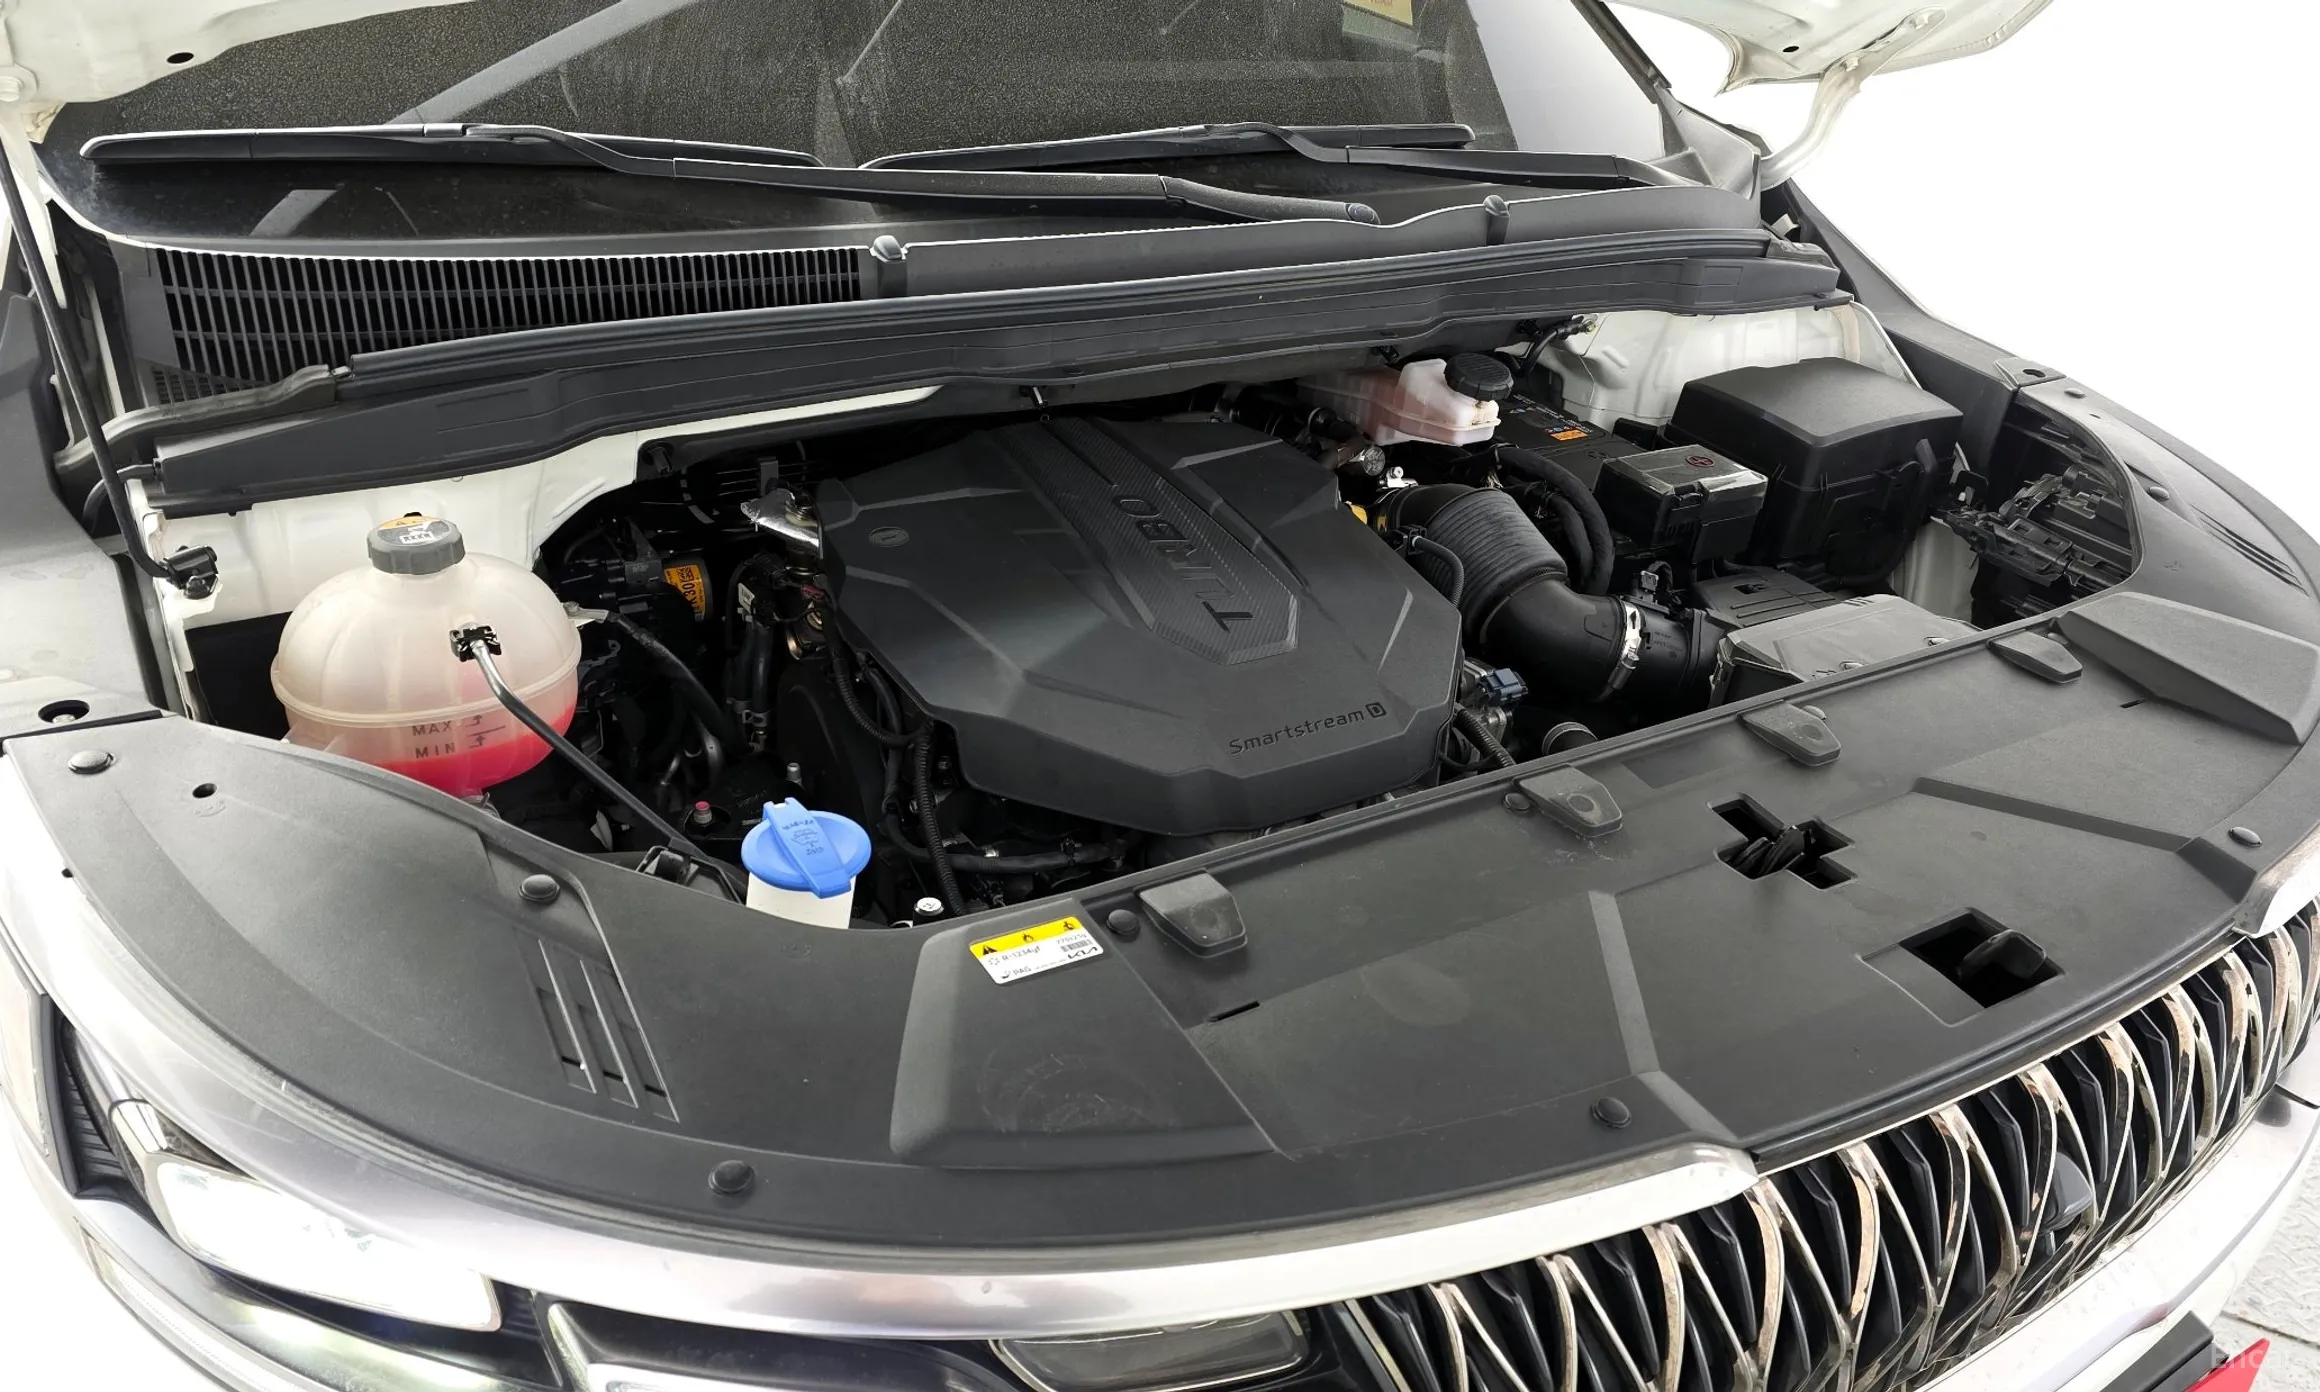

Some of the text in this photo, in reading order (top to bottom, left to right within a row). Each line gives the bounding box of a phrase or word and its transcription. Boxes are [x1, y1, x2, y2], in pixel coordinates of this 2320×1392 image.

[1113, 495, 1256, 632] TURBO
[412, 720, 452, 736] MAX
[1229, 709, 1364, 755] Smartstream
[415, 742, 455, 759] MIN
[1001, 946, 1041, 961] R-1234yf
